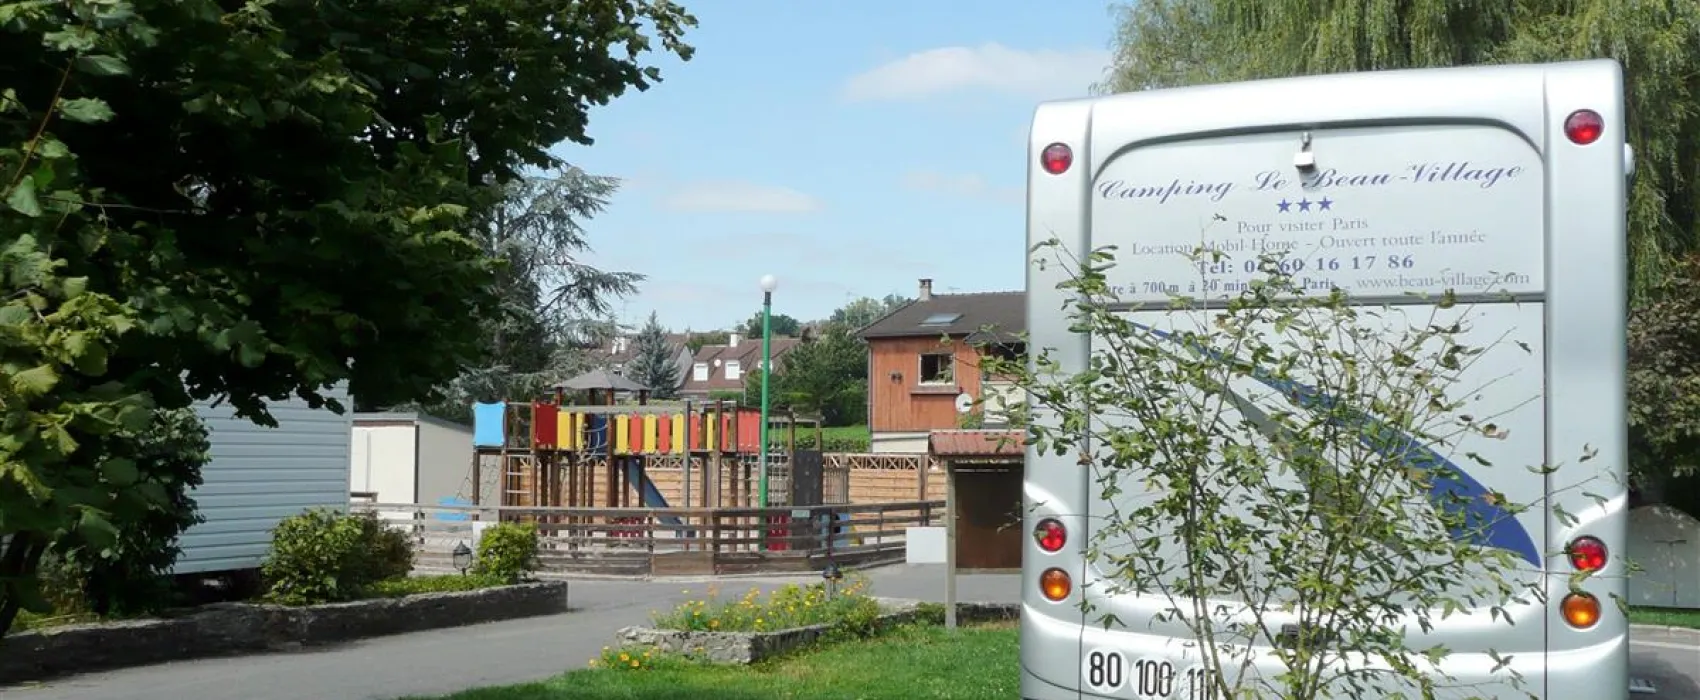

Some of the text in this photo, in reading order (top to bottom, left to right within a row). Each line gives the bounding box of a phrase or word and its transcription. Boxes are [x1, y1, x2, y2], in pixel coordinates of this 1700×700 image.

[1099, 179, 1233, 204] Camping
[1253, 170, 1289, 191] Le
[1237, 217, 1369, 234] Pour visiter Paris
[1132, 242, 1193, 256] Location
[1319, 235, 1376, 248] Ouvert
[1382, 234, 1424, 247] toute
[1430, 228, 1487, 244] l'année
[1279, 257, 1305, 272] 60
[1316, 257, 1340, 271] 16
[1351, 255, 1376, 270] 17
[1387, 254, 1414, 269] 86
[1089, 651, 1122, 687] 80
[1136, 659, 1172, 697] 100
